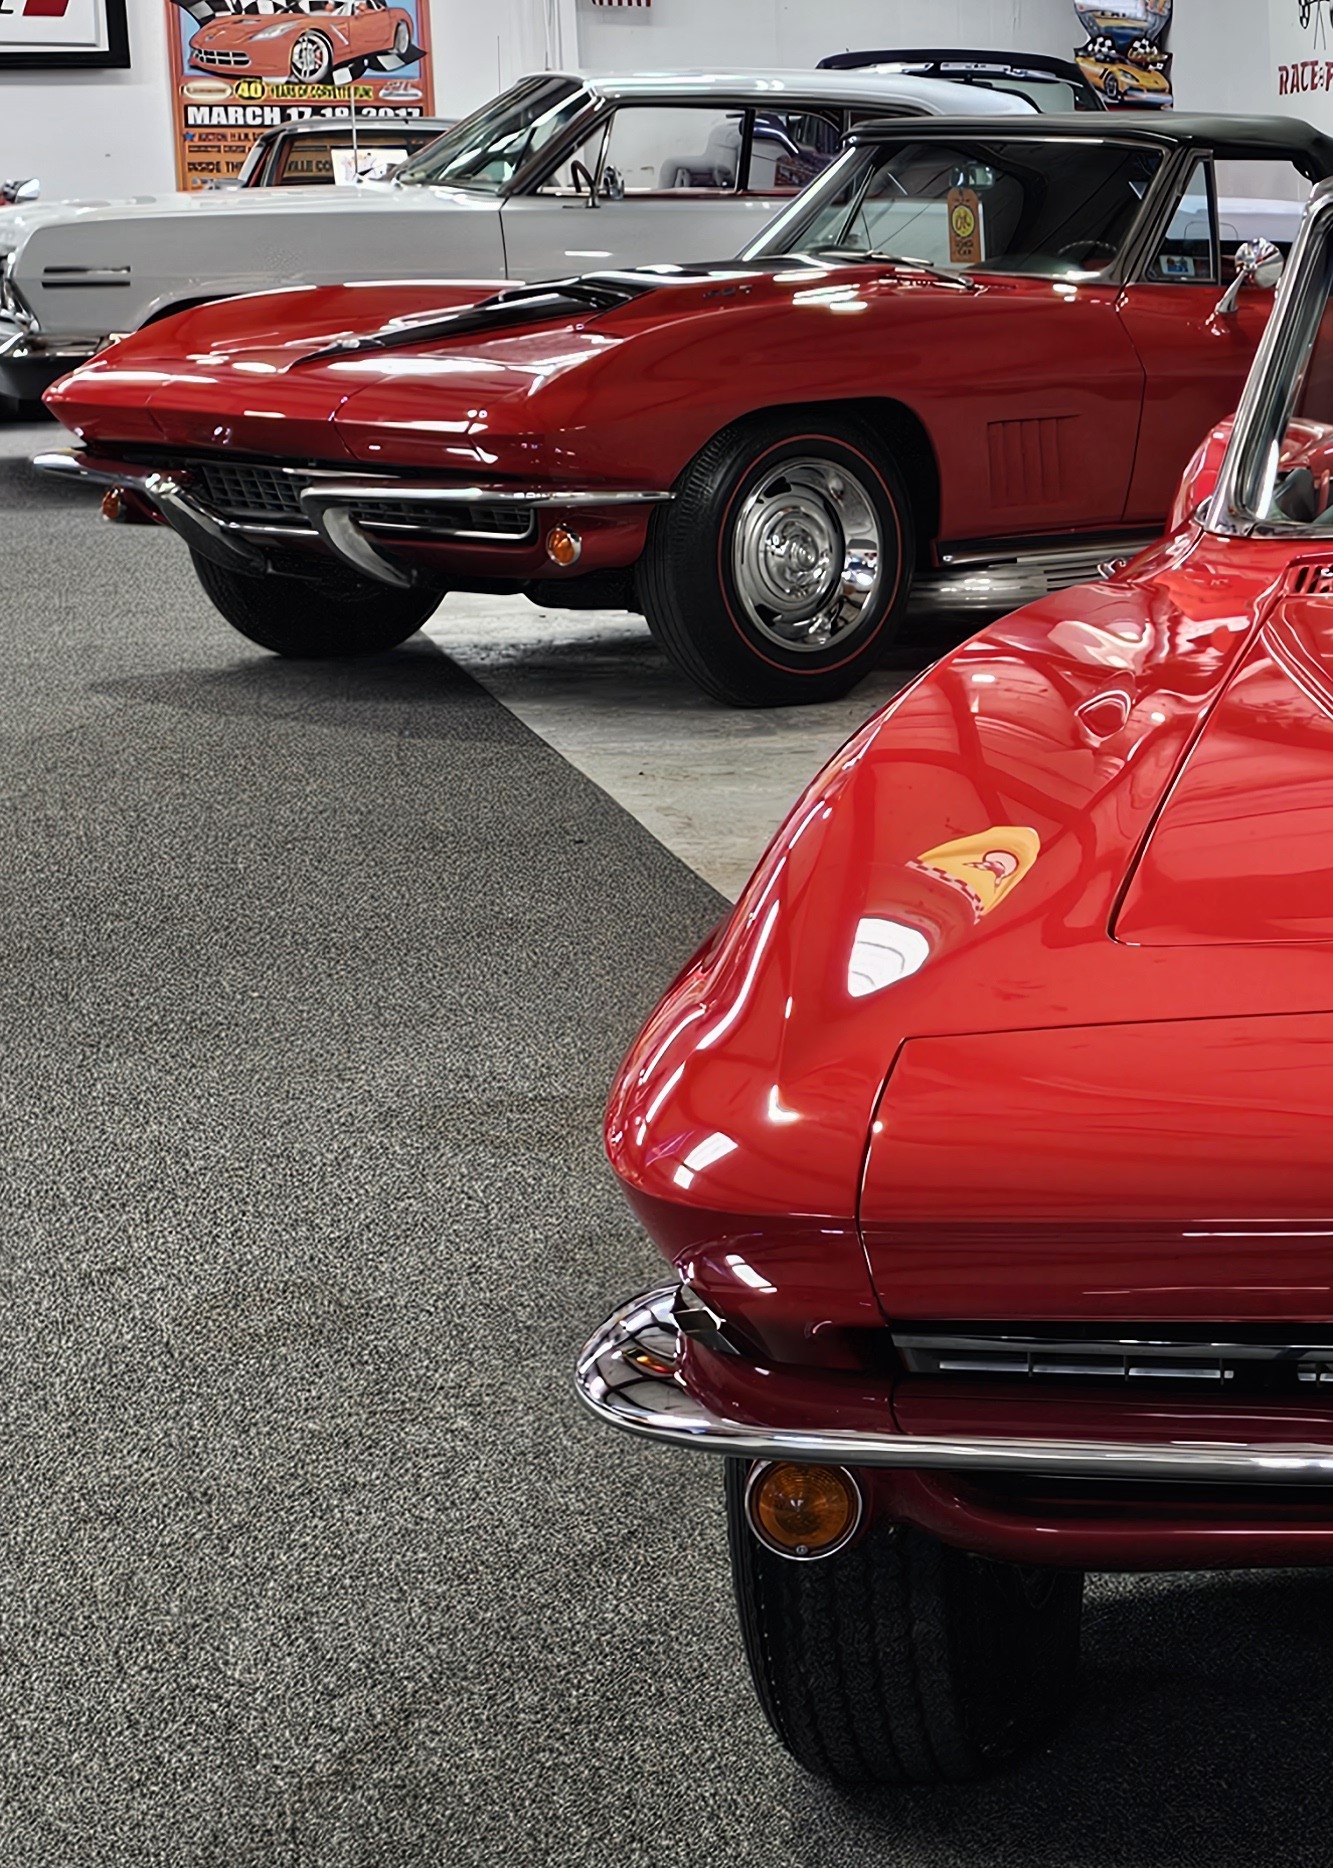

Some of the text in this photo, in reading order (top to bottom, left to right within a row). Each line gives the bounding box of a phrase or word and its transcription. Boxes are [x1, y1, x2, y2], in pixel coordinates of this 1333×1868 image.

[1277, 59, 1319, 96] RACE
[237, 81, 263, 99] 40
[187, 106, 281, 126] MARCH
